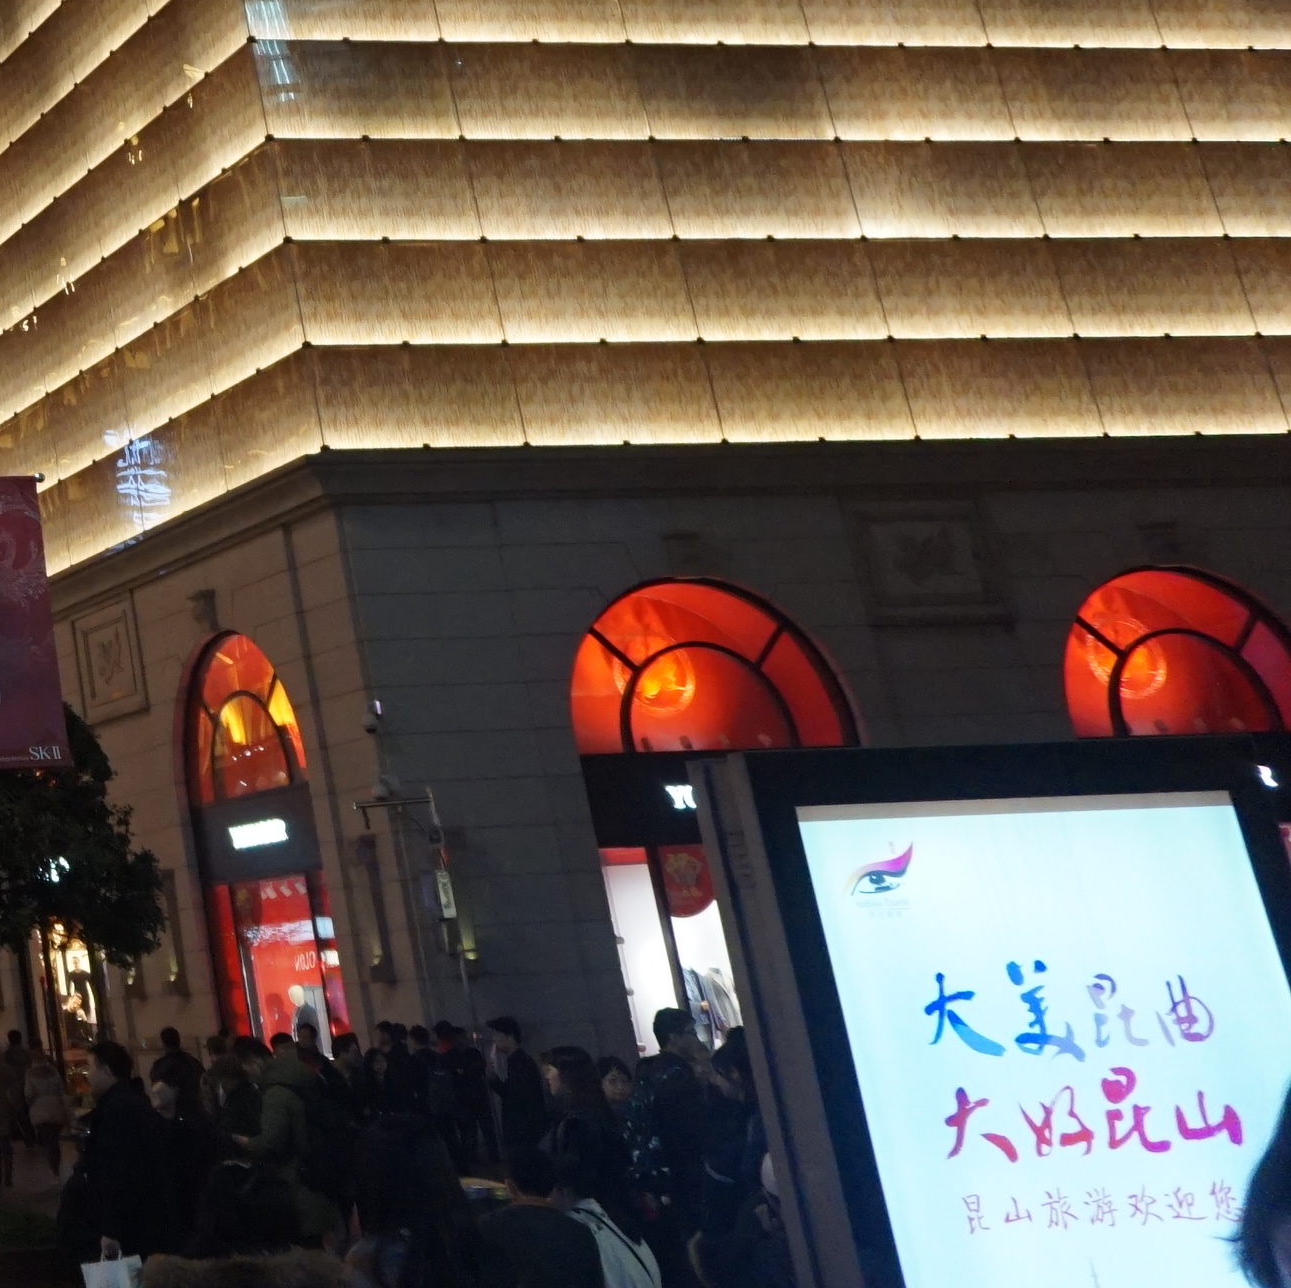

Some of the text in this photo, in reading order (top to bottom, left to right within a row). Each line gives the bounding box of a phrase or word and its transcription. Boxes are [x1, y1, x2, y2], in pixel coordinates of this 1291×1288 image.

[924, 960, 1214, 1062] 大美昆曲
[945, 1066, 1243, 1163] 大好昆山
